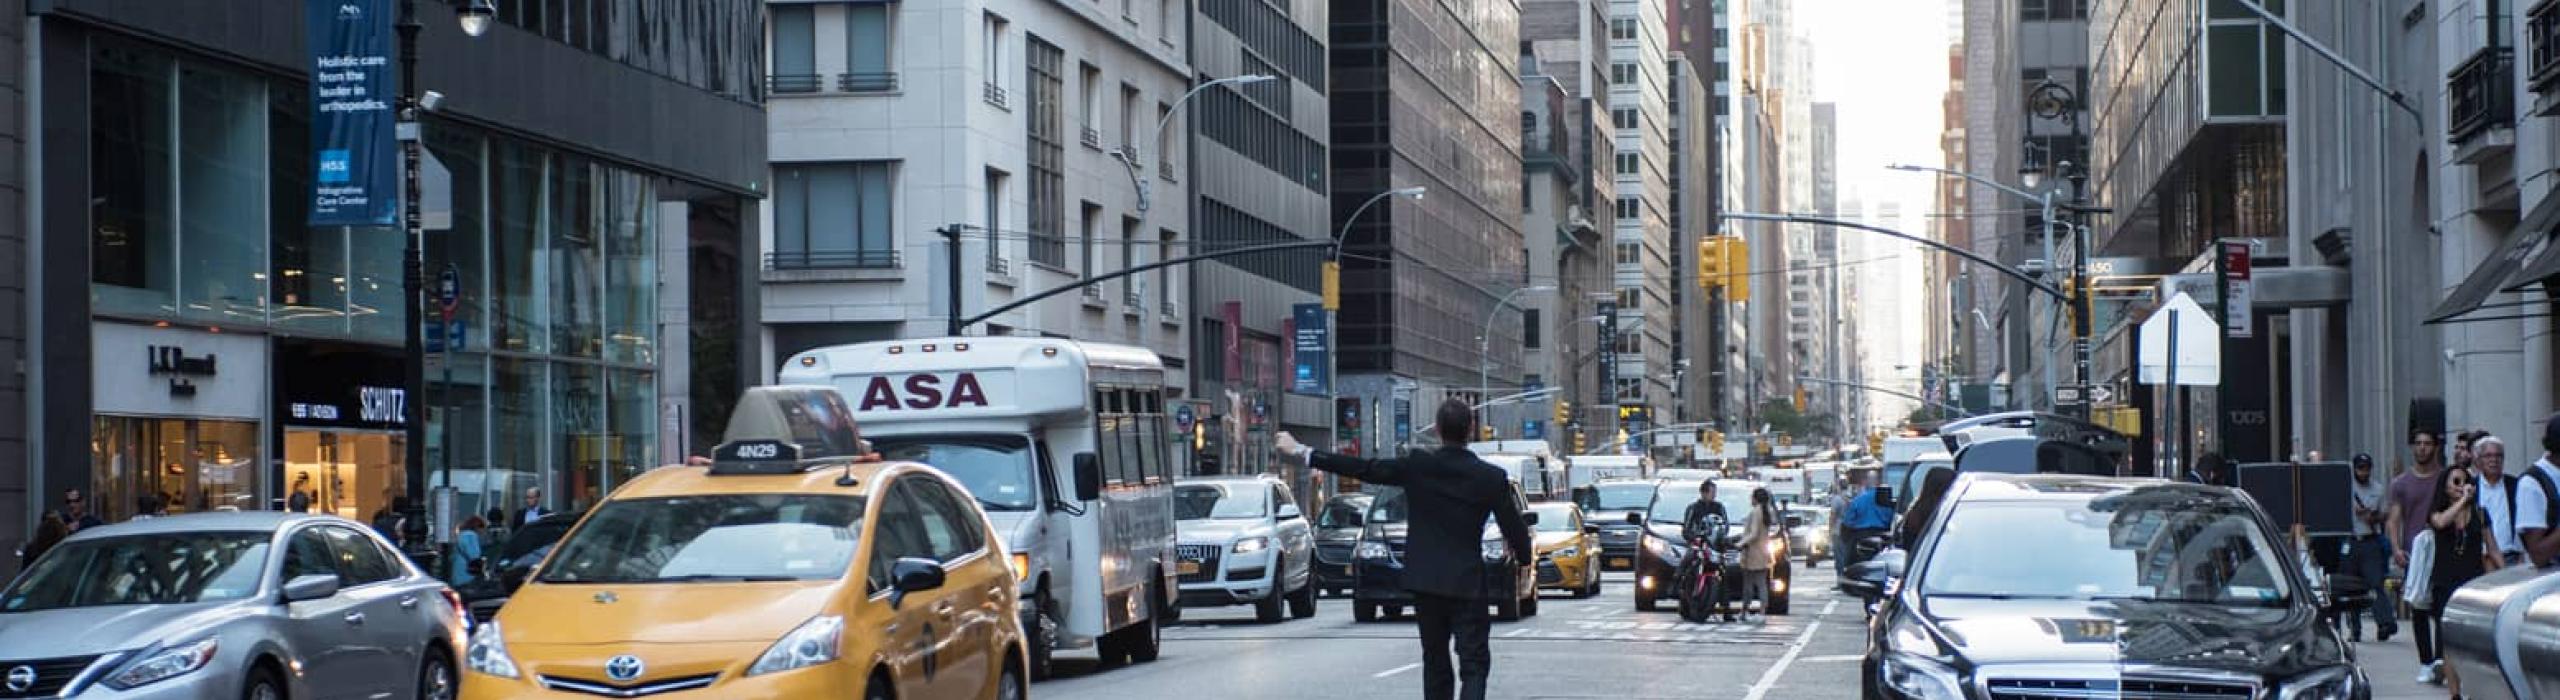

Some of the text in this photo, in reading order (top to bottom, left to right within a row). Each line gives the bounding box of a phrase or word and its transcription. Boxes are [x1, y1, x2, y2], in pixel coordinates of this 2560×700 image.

[318, 55, 386, 67] Holistic care
[319, 70, 365, 82] from the
[353, 86, 365, 95] in
[859, 372, 989, 411] ASA
[360, 386, 405, 423] SCHUTZ
[737, 443, 777, 458] 4N29
